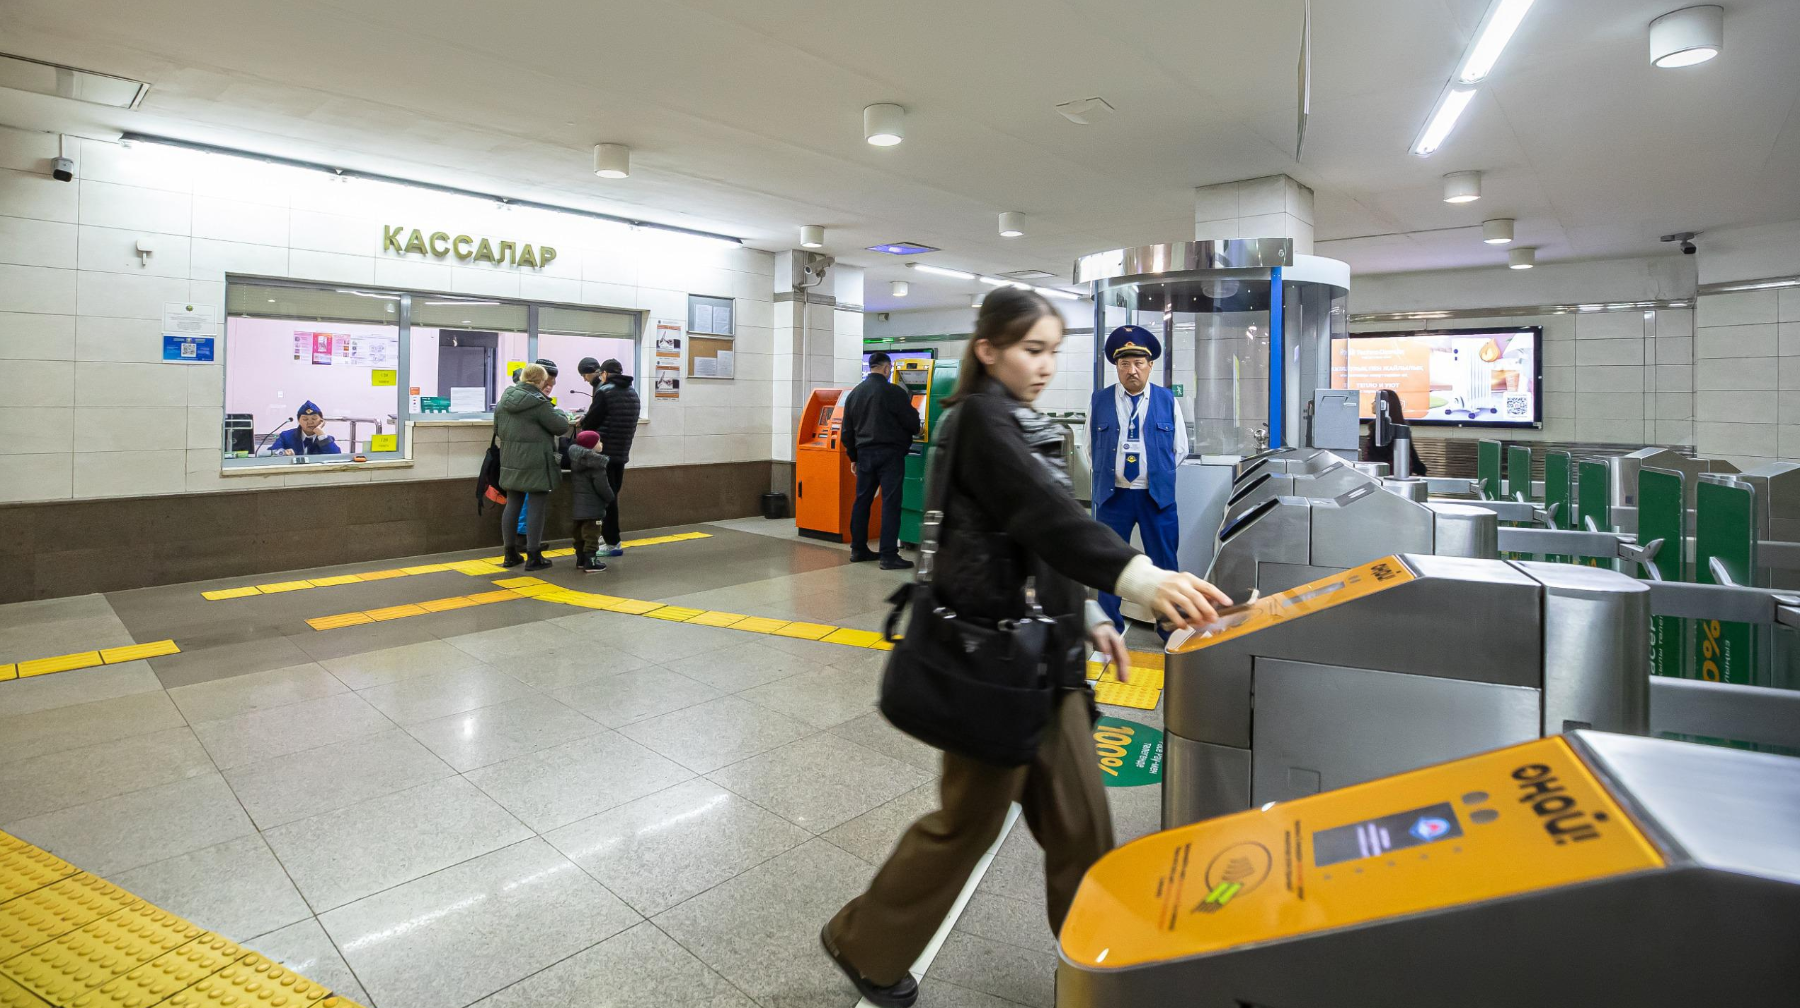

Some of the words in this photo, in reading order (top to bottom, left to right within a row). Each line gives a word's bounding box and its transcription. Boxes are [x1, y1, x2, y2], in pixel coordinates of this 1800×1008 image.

[384, 224, 557, 269] КАССАЛАР
[1702, 619, 1720, 682] 0%
[1723, 639, 1731, 684] лыңыз
